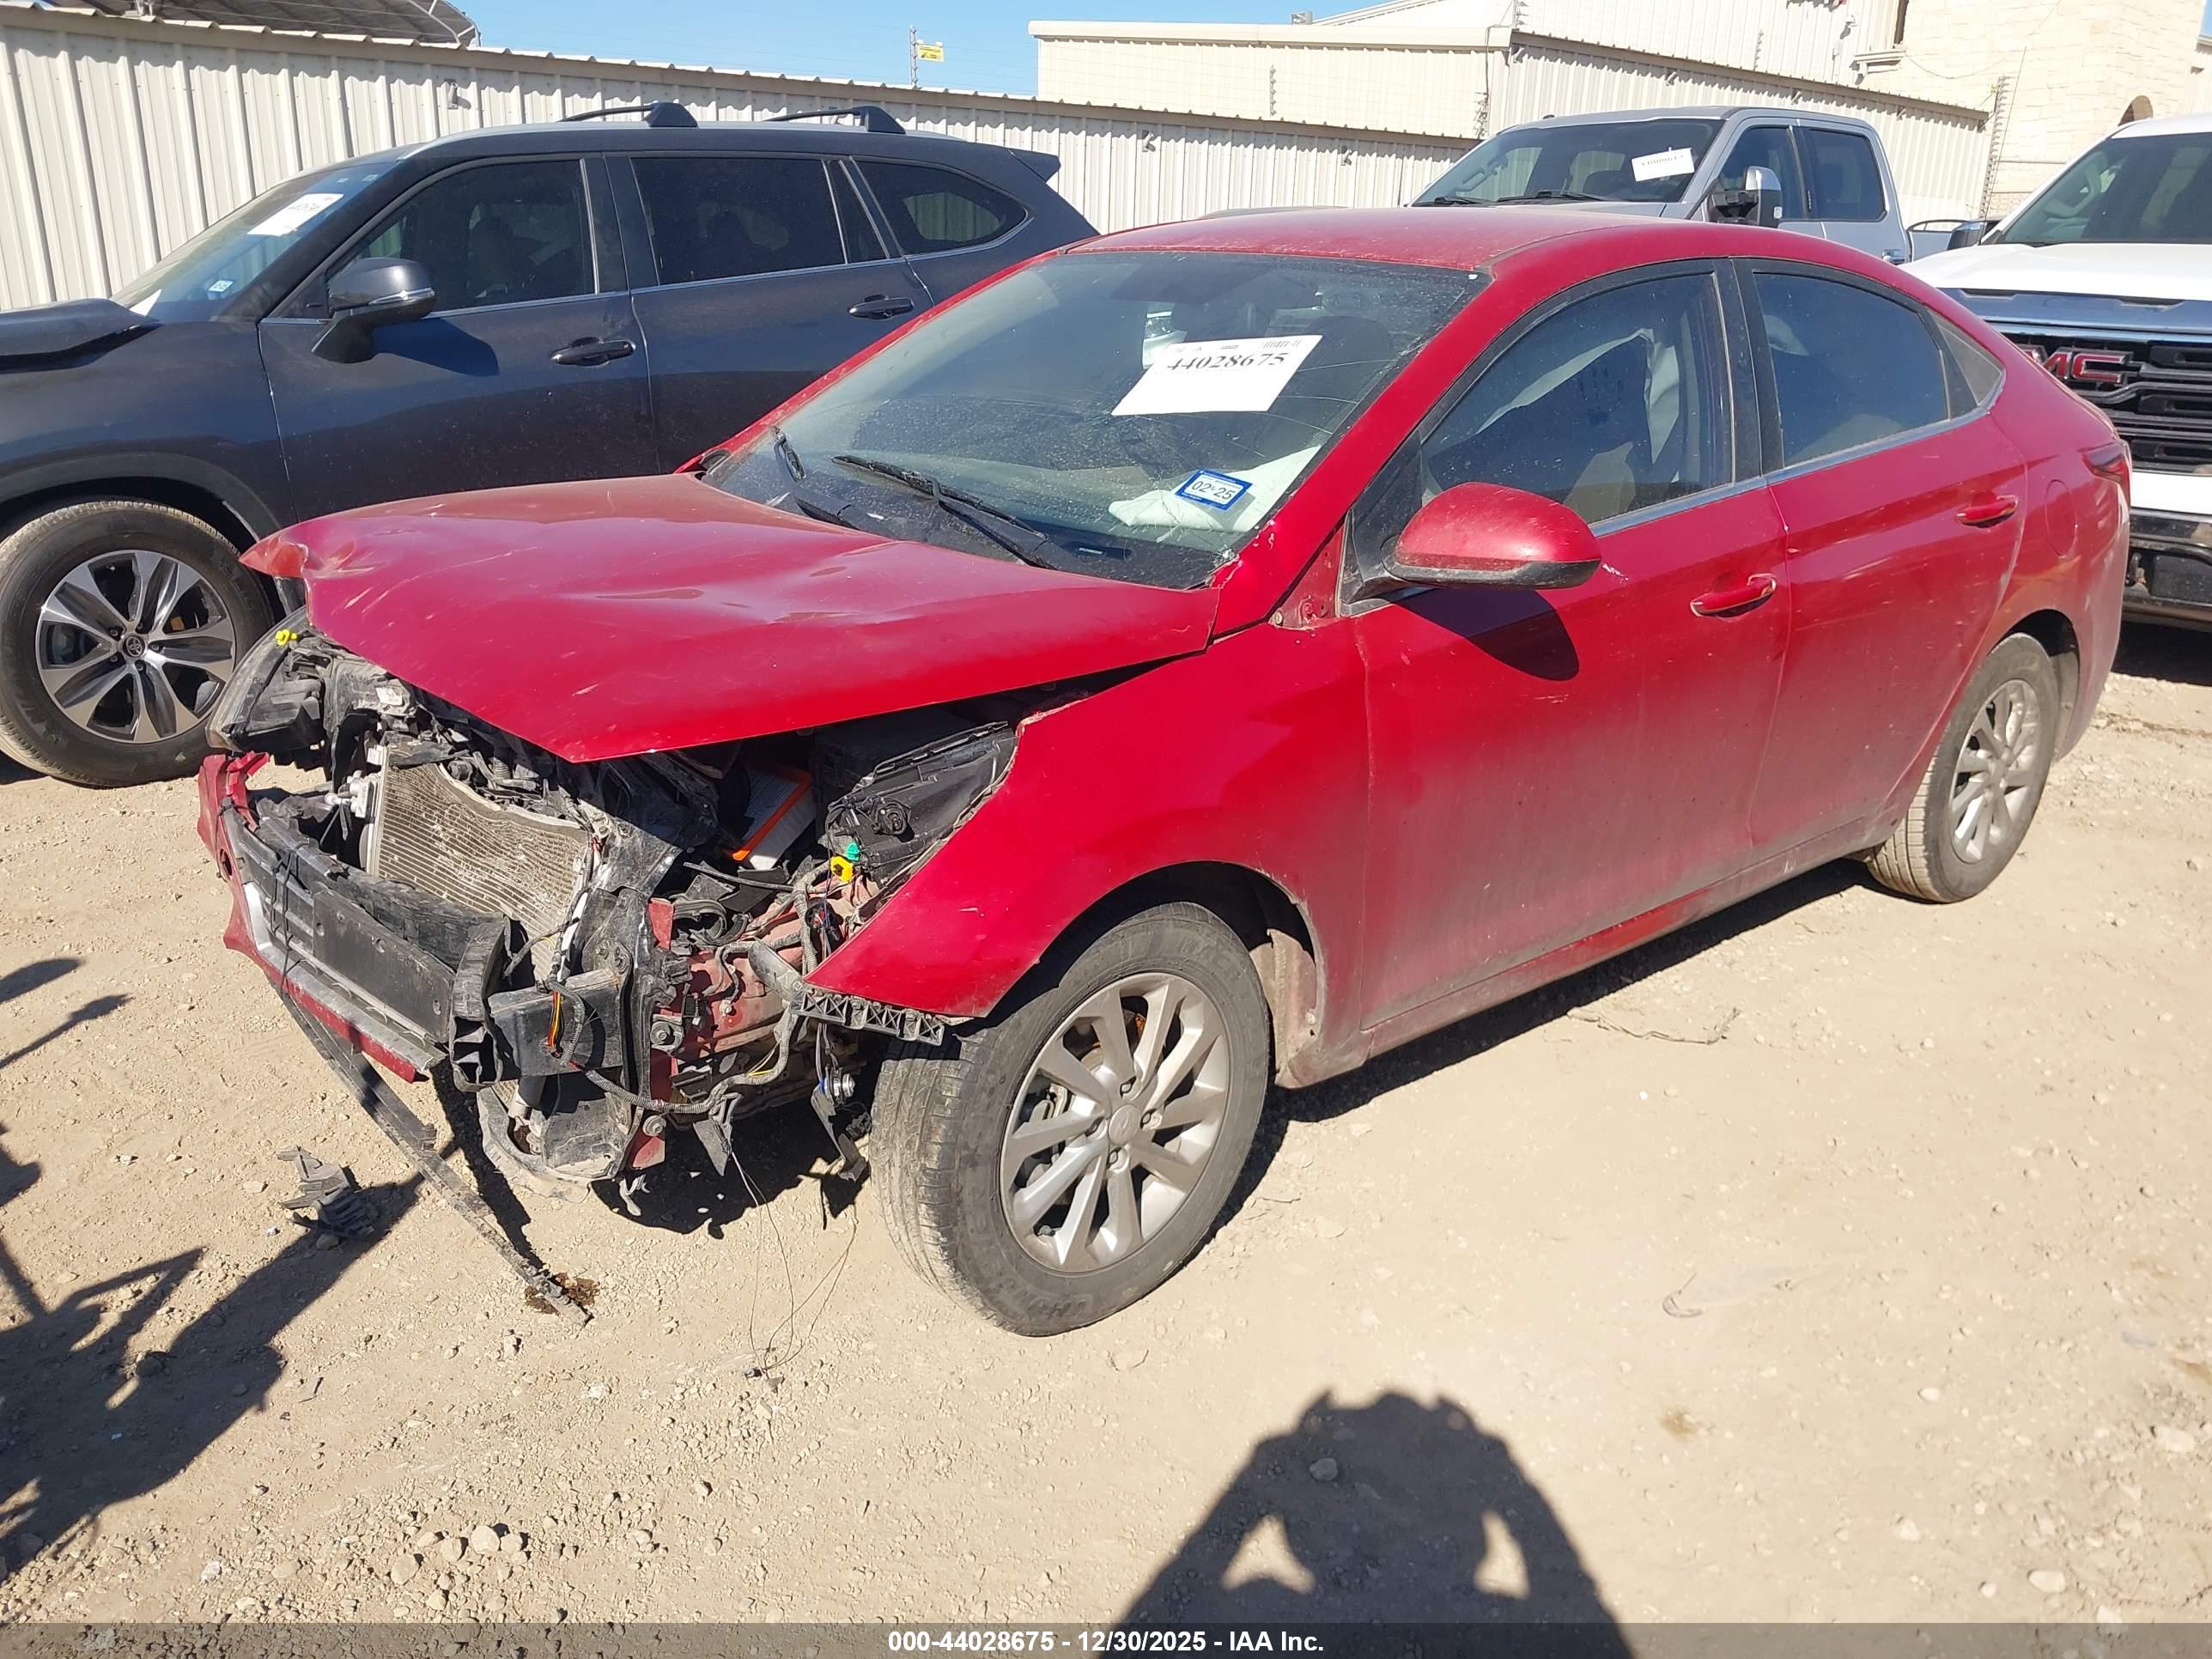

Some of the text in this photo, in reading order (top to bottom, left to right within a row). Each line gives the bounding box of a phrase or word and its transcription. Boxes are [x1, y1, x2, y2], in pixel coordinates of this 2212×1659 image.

[1167, 351, 1291, 371] 44028675
[2023, 349, 2125, 384] MC
[1191, 480, 1212, 493] 02
[1212, 487, 1237, 501] 25
